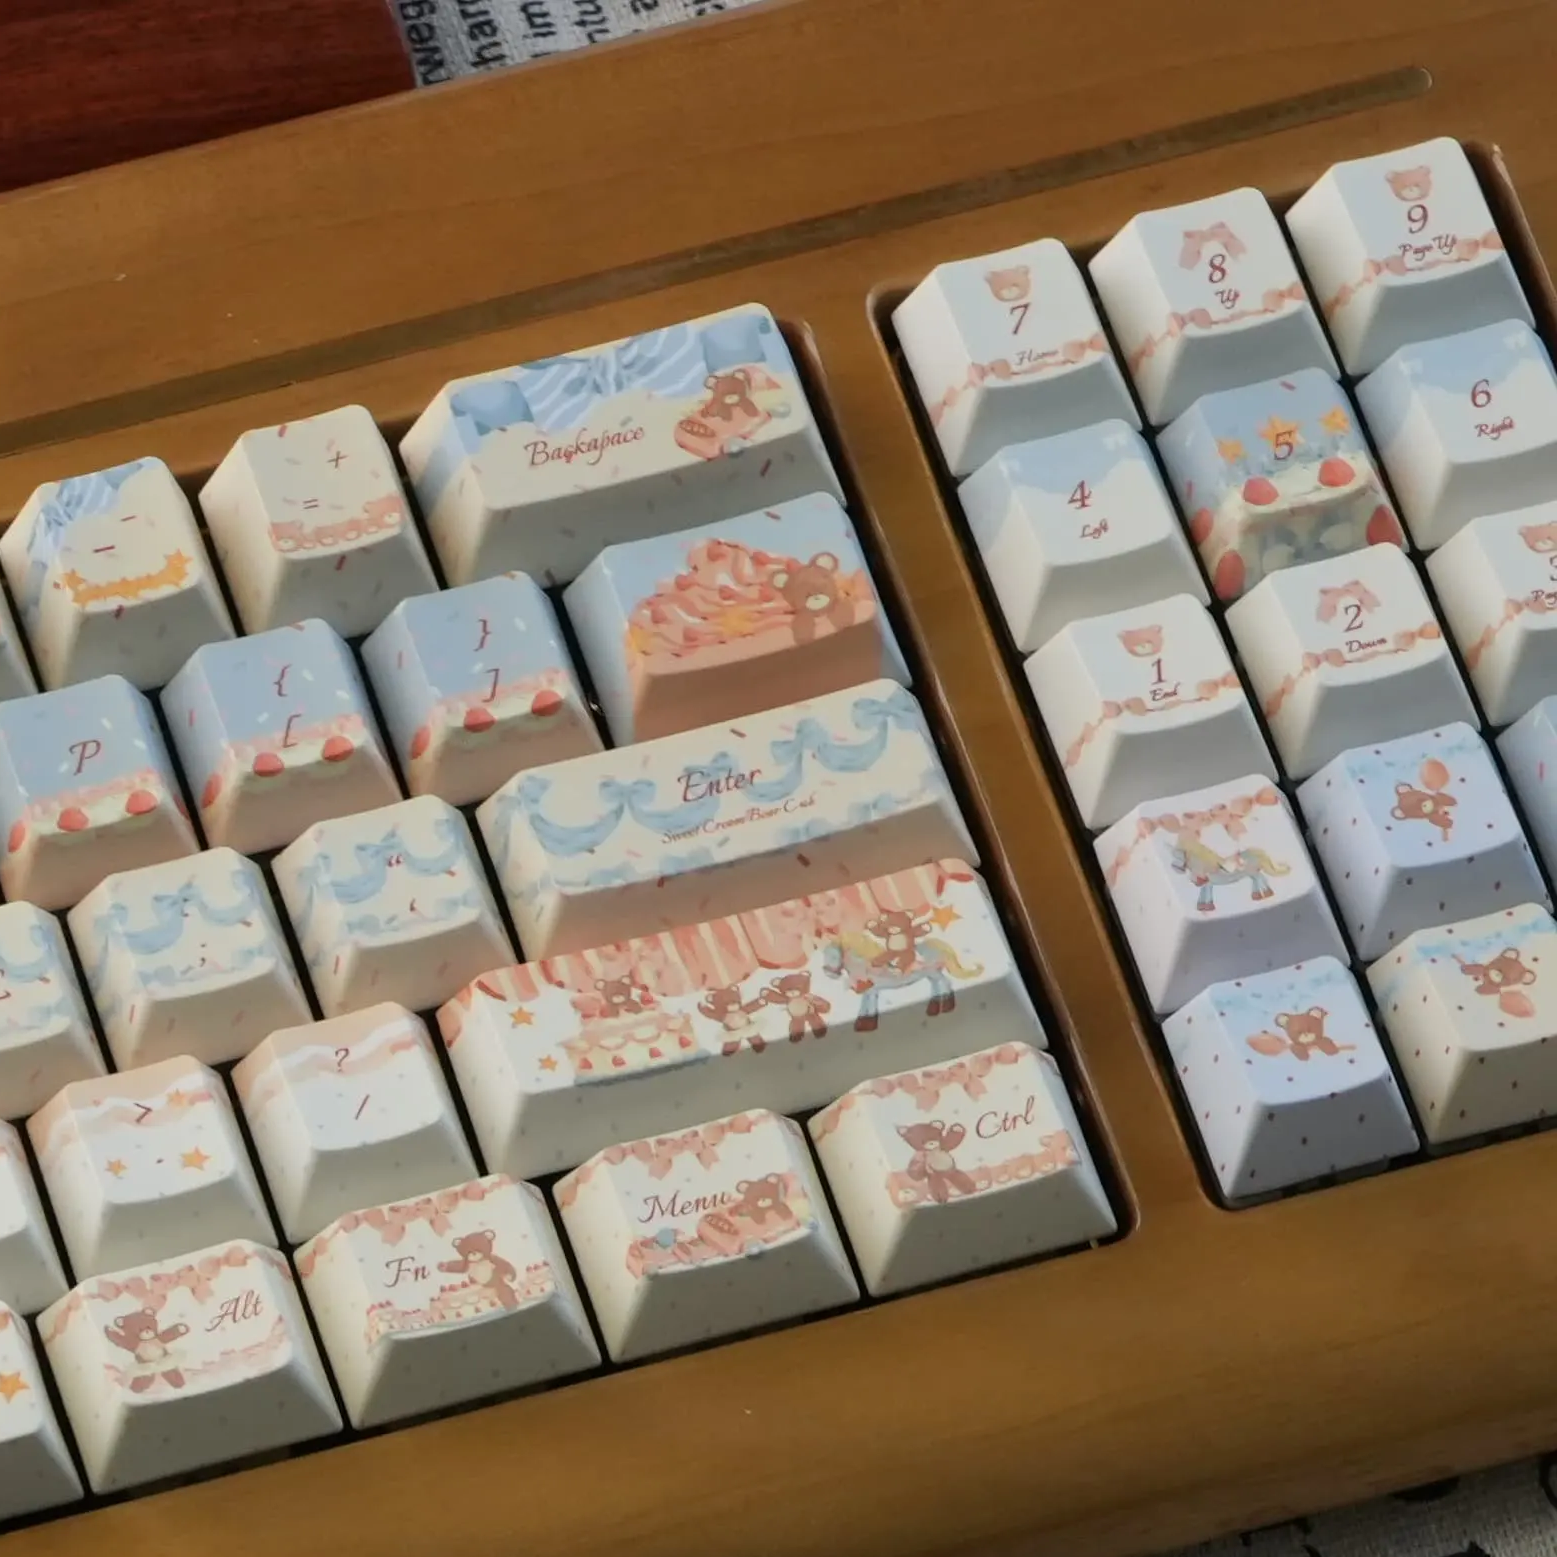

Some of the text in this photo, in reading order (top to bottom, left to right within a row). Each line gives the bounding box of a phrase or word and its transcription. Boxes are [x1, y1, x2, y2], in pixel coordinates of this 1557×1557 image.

[1408, 205, 1428, 234] 9
[1208, 254, 1228, 283] 8
[1009, 303, 1029, 336] 7
[1471, 379, 1491, 409] 6
[1345, 605, 1364, 632] 2
[1151, 658, 1165, 684] 1
[70, 739, 103, 773] P
[677, 768, 762, 802] Enter
[977, 1097, 1037, 1140] Ctrl
[637, 1190, 733, 1223] Menu
[384, 1256, 431, 1290] Fn
[204, 1294, 266, 1334] Alt
